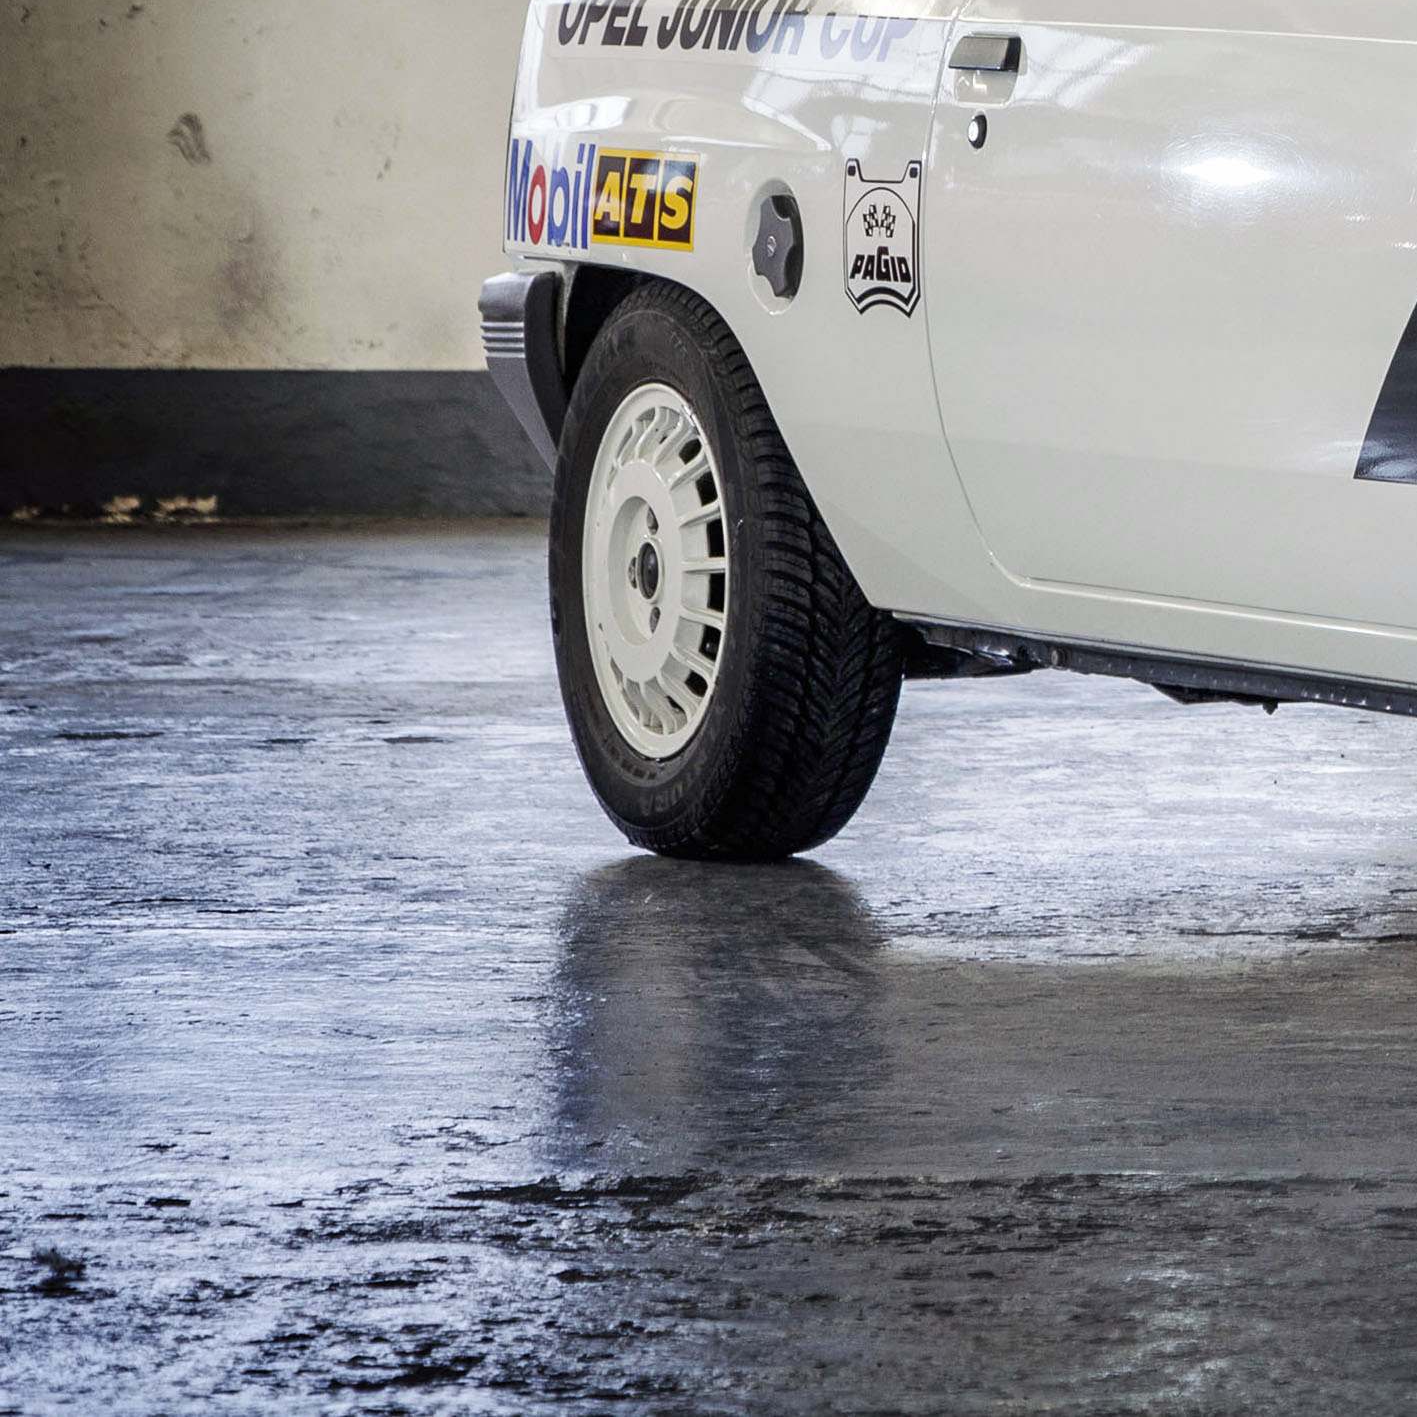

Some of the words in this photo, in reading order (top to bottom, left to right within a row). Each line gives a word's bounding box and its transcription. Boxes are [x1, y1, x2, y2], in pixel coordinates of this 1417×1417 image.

[506, 138, 597, 250] Mobil
[593, 170, 695, 231] ATS
[849, 245, 912, 283] PAGID
